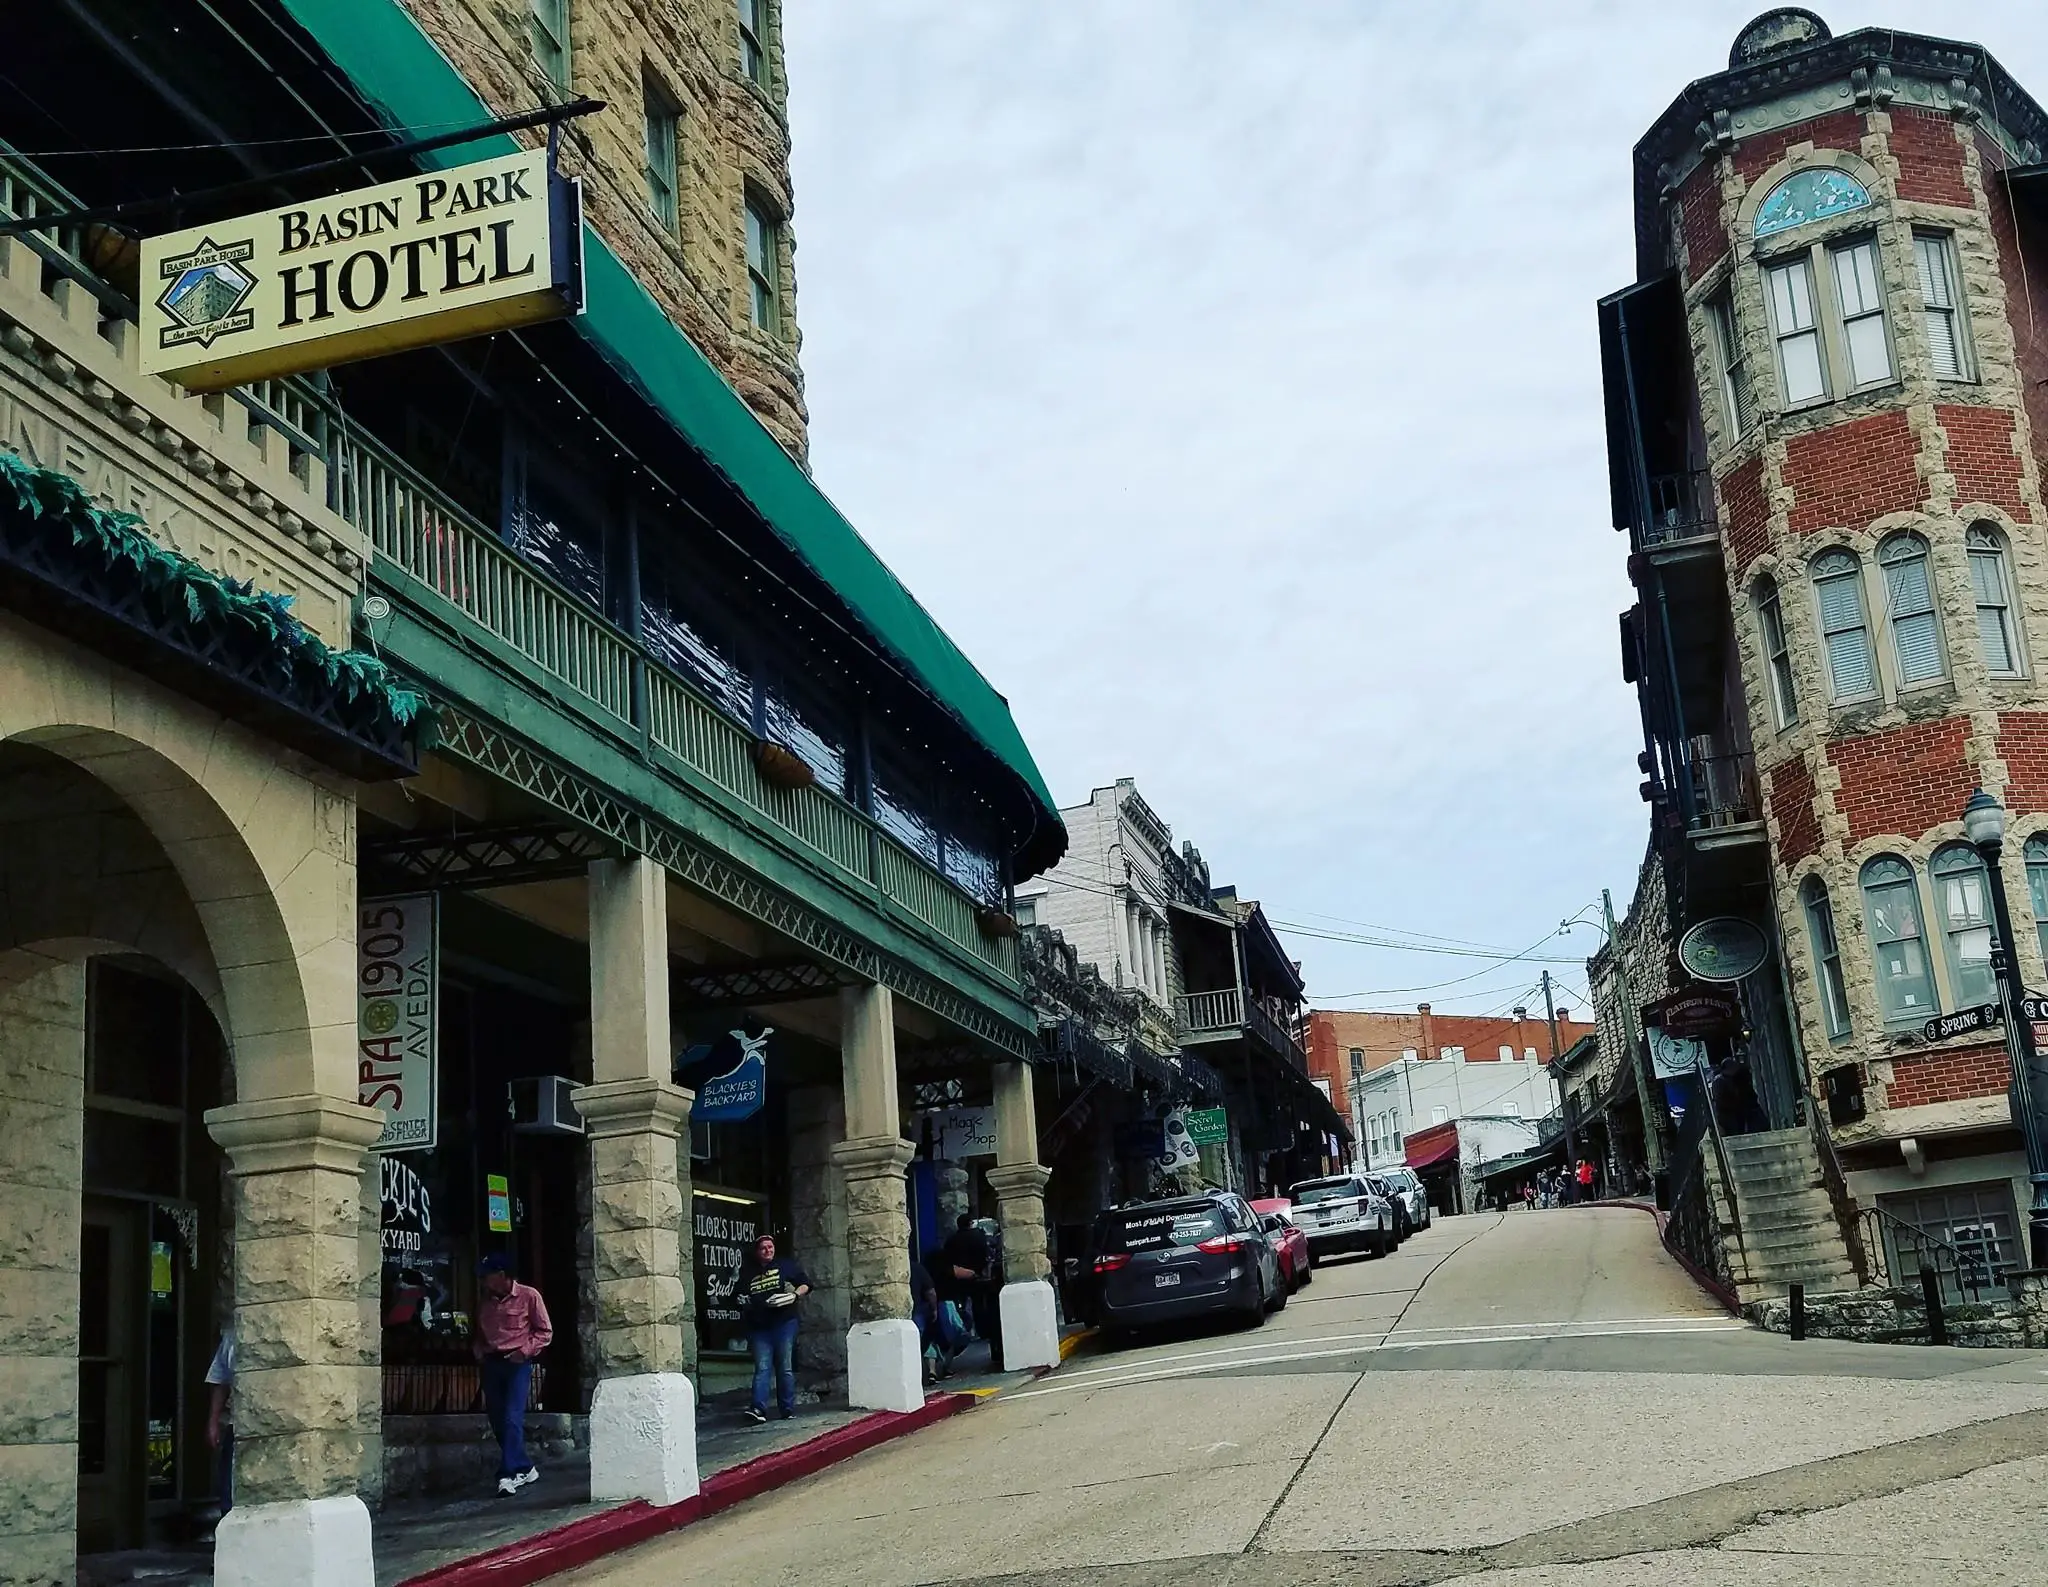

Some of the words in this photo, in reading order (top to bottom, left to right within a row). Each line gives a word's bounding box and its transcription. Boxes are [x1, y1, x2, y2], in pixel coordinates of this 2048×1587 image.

[278, 196, 402, 256] BASIN
[415, 167, 532, 225] PARK
[166, 260, 192, 273] BASIN
[193, 254, 217, 267] PARK
[219, 248, 249, 260] HOTEL
[276, 219, 536, 329] HOTEL
[230, 318, 248, 328] here
[361, 904, 405, 1000] 1905
[406, 956, 429, 1059] AVEDA
[1940, 1012, 1979, 1036] SPRING
[358, 1035, 403, 1113] SPA
[703, 1090, 757, 1108] BACKYARD
[704, 1079, 757, 1096] BLACKIE'S
[391, 1118, 427, 1131] CENTER
[396, 1128, 427, 1141] FLOOR
[1194, 1122, 1225, 1133] Garden
[962, 1123, 997, 1150] Shop
[729, 1220, 756, 1243] LUCK
[1125, 1219, 1142, 1230] Most
[1165, 1212, 1201, 1222] Downtown
[1125, 1235, 1162, 1248] basinpark.com
[702, 1243, 742, 1269] TATTOO
